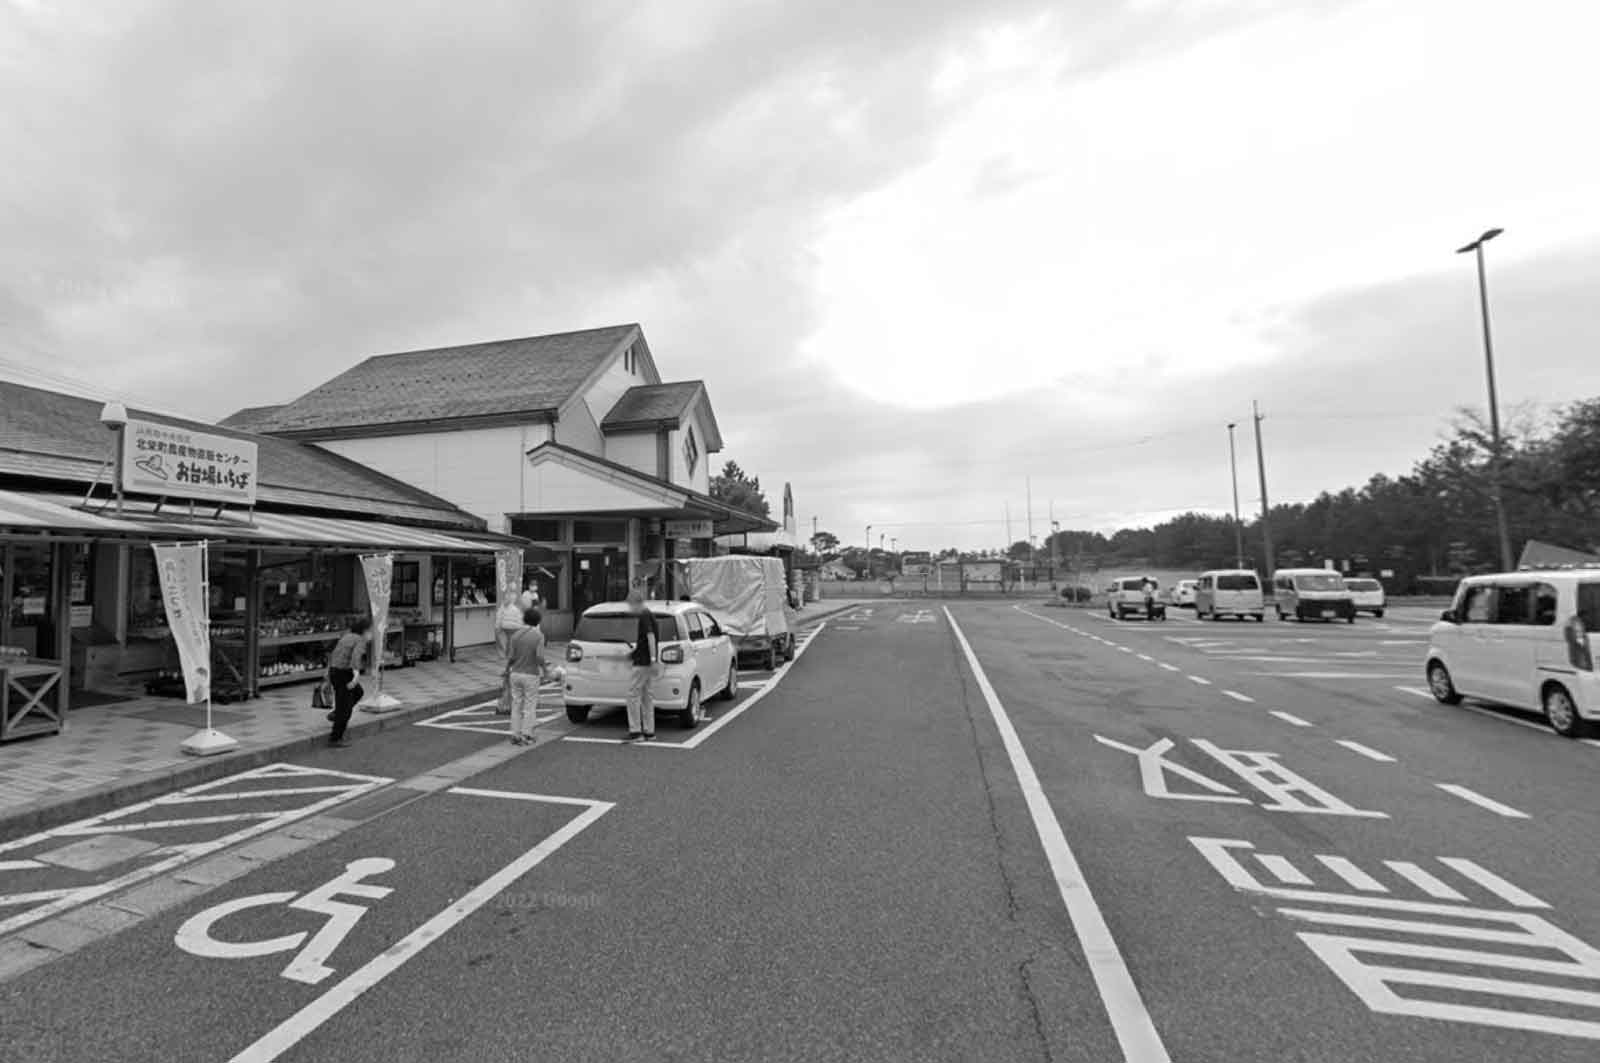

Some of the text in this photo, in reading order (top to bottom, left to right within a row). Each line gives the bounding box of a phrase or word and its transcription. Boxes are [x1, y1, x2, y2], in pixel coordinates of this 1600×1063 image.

[176, 461, 251, 489] お台場いちば
